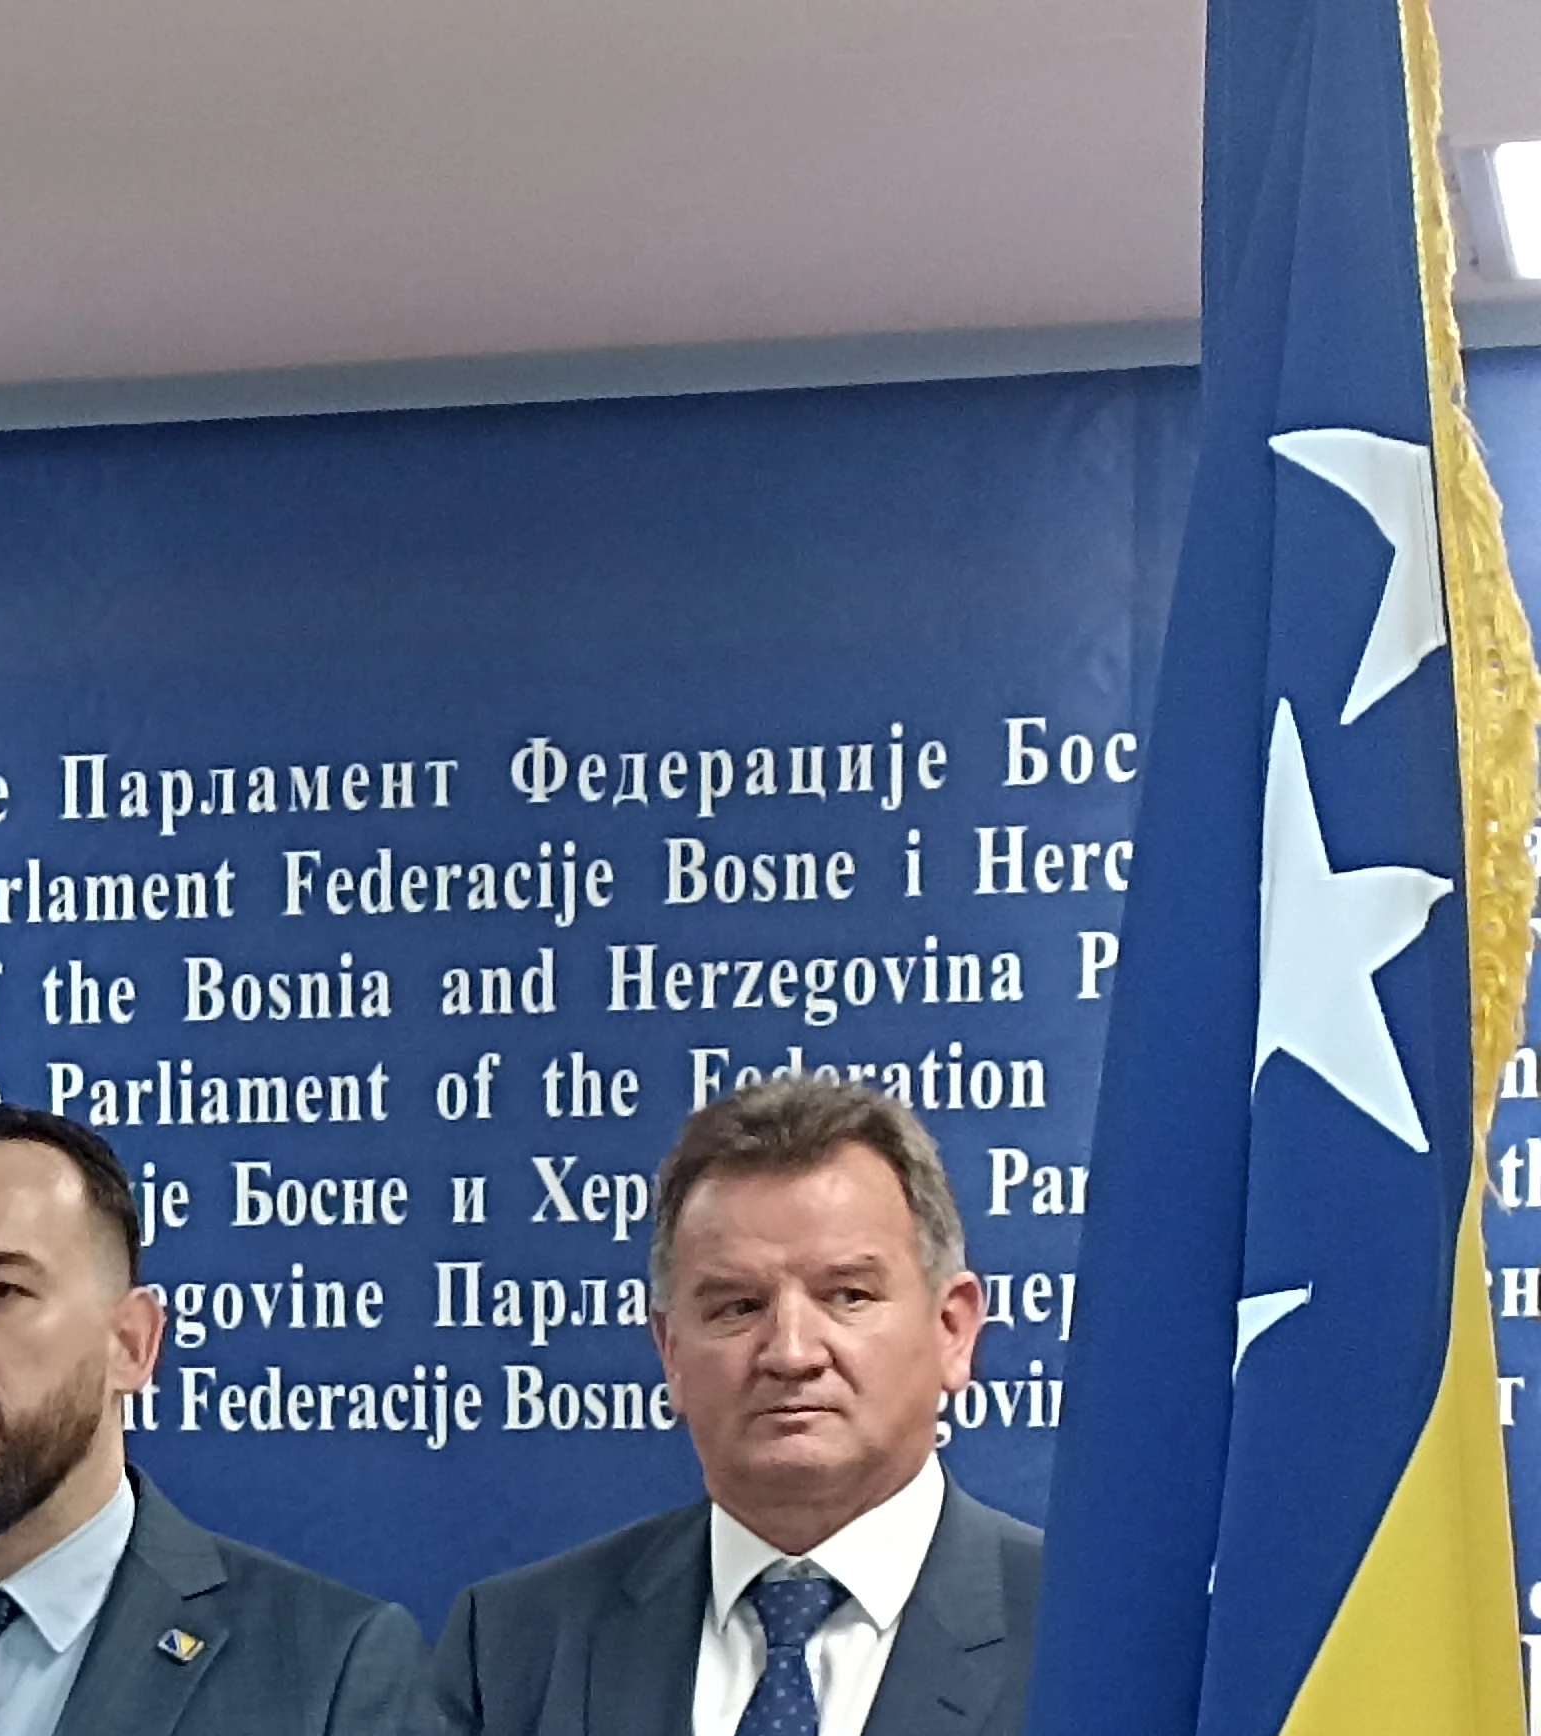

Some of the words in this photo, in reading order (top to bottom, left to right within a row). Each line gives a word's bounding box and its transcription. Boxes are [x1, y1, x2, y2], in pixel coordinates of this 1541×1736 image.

[62, 754, 457, 836] Парламент
[511, 723, 946, 817] Федерације
[1004, 718, 1136, 785] Бос
[284, 841, 613, 927] Federacije
[665, 839, 855, 904] Bosne
[906, 829, 921, 896] i
[43, 961, 135, 1024] the
[185, 953, 391, 1021] Bosnia
[443, 948, 555, 1015] and
[608, 936, 1023, 1026] Herzegovina
[47, 1060, 389, 1126] Parliament
[437, 1053, 500, 1120] of
[543, 1052, 638, 1117] the
[232, 1162, 407, 1226] Босне
[453, 1178, 485, 1222] и
[149, 1263, 384, 1349] govine
[434, 1262, 648, 1347] Парла
[179, 1365, 481, 1449] Federacije
[503, 1365, 678, 1431] Bosne
